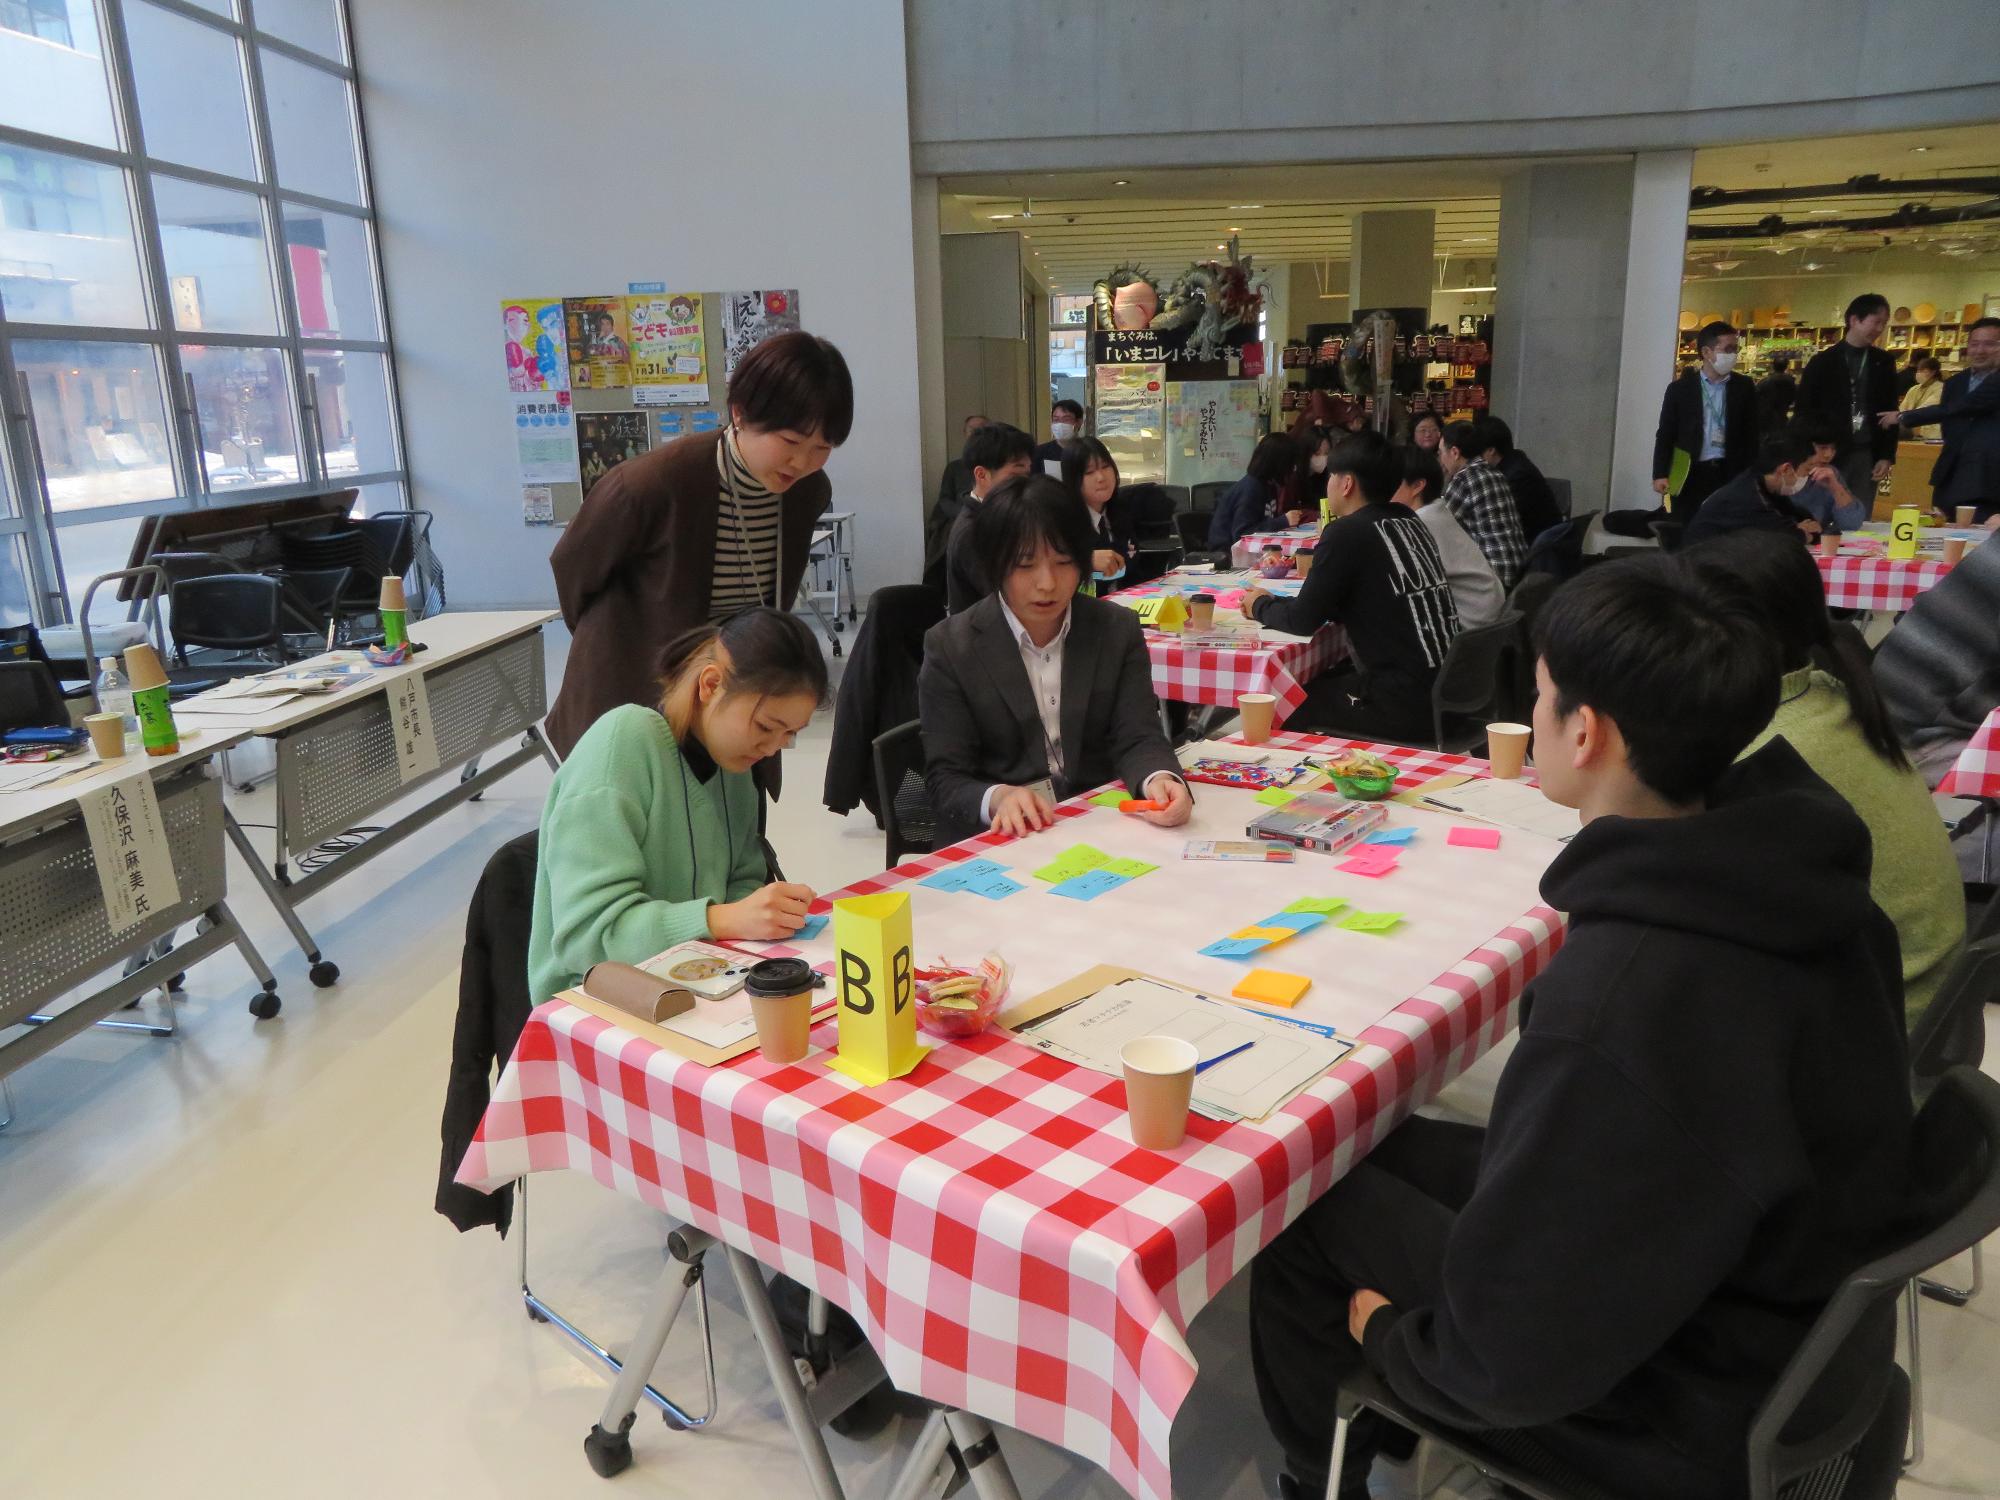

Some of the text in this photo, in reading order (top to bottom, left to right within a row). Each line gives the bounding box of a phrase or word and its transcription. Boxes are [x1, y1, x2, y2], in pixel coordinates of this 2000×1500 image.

[1894, 522, 1913, 541] G
[841, 948, 875, 1015] B
[892, 945, 910, 1016] B
